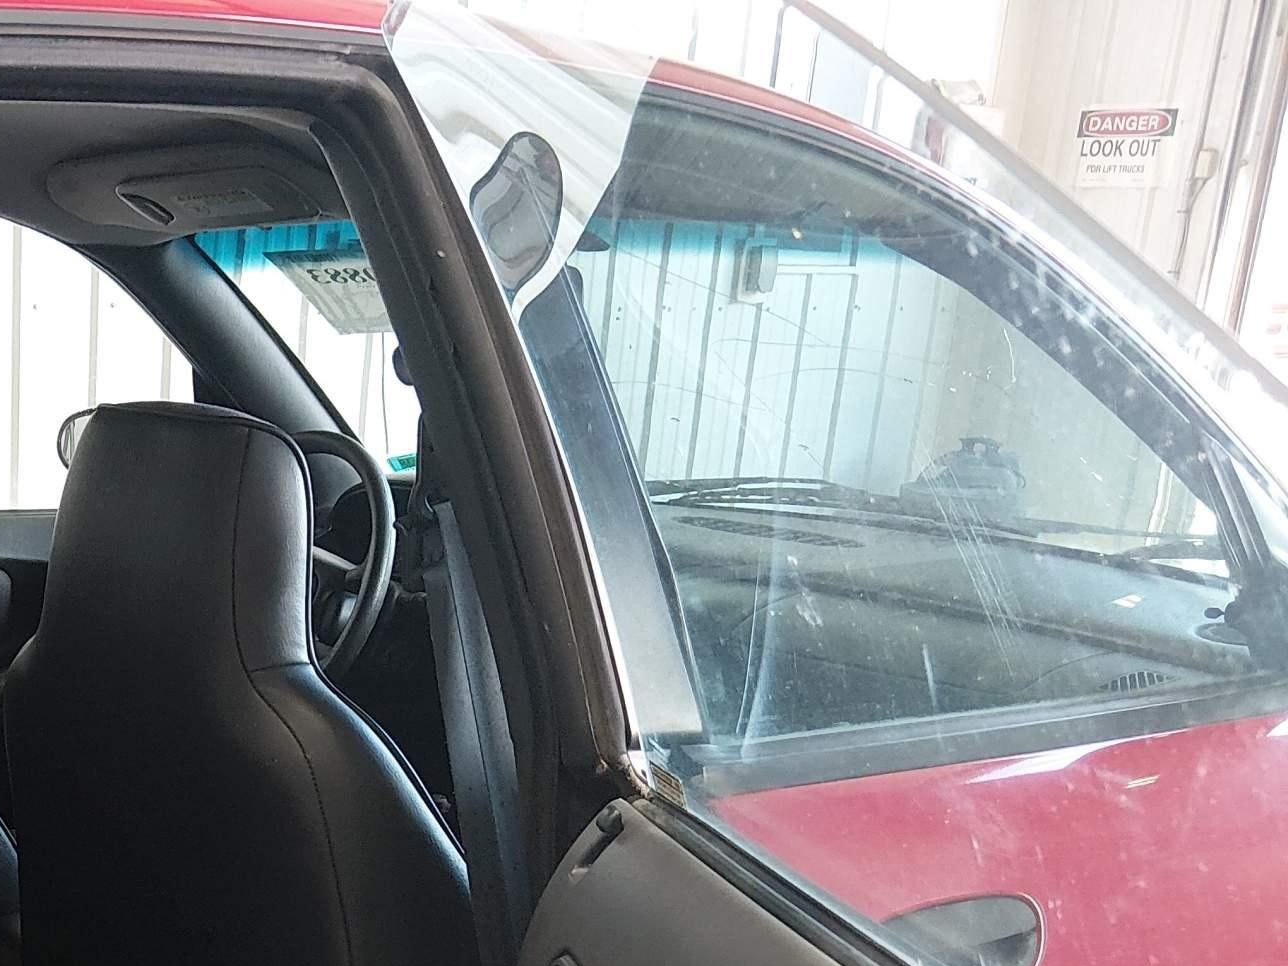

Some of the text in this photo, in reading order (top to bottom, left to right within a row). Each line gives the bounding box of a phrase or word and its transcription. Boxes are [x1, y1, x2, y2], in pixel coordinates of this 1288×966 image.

[1088, 115, 1160, 132] DANGER
[1080, 139, 1161, 158] LOOK OUT
[1086, 164, 1145, 174] FOR LIFT TRUCKS
